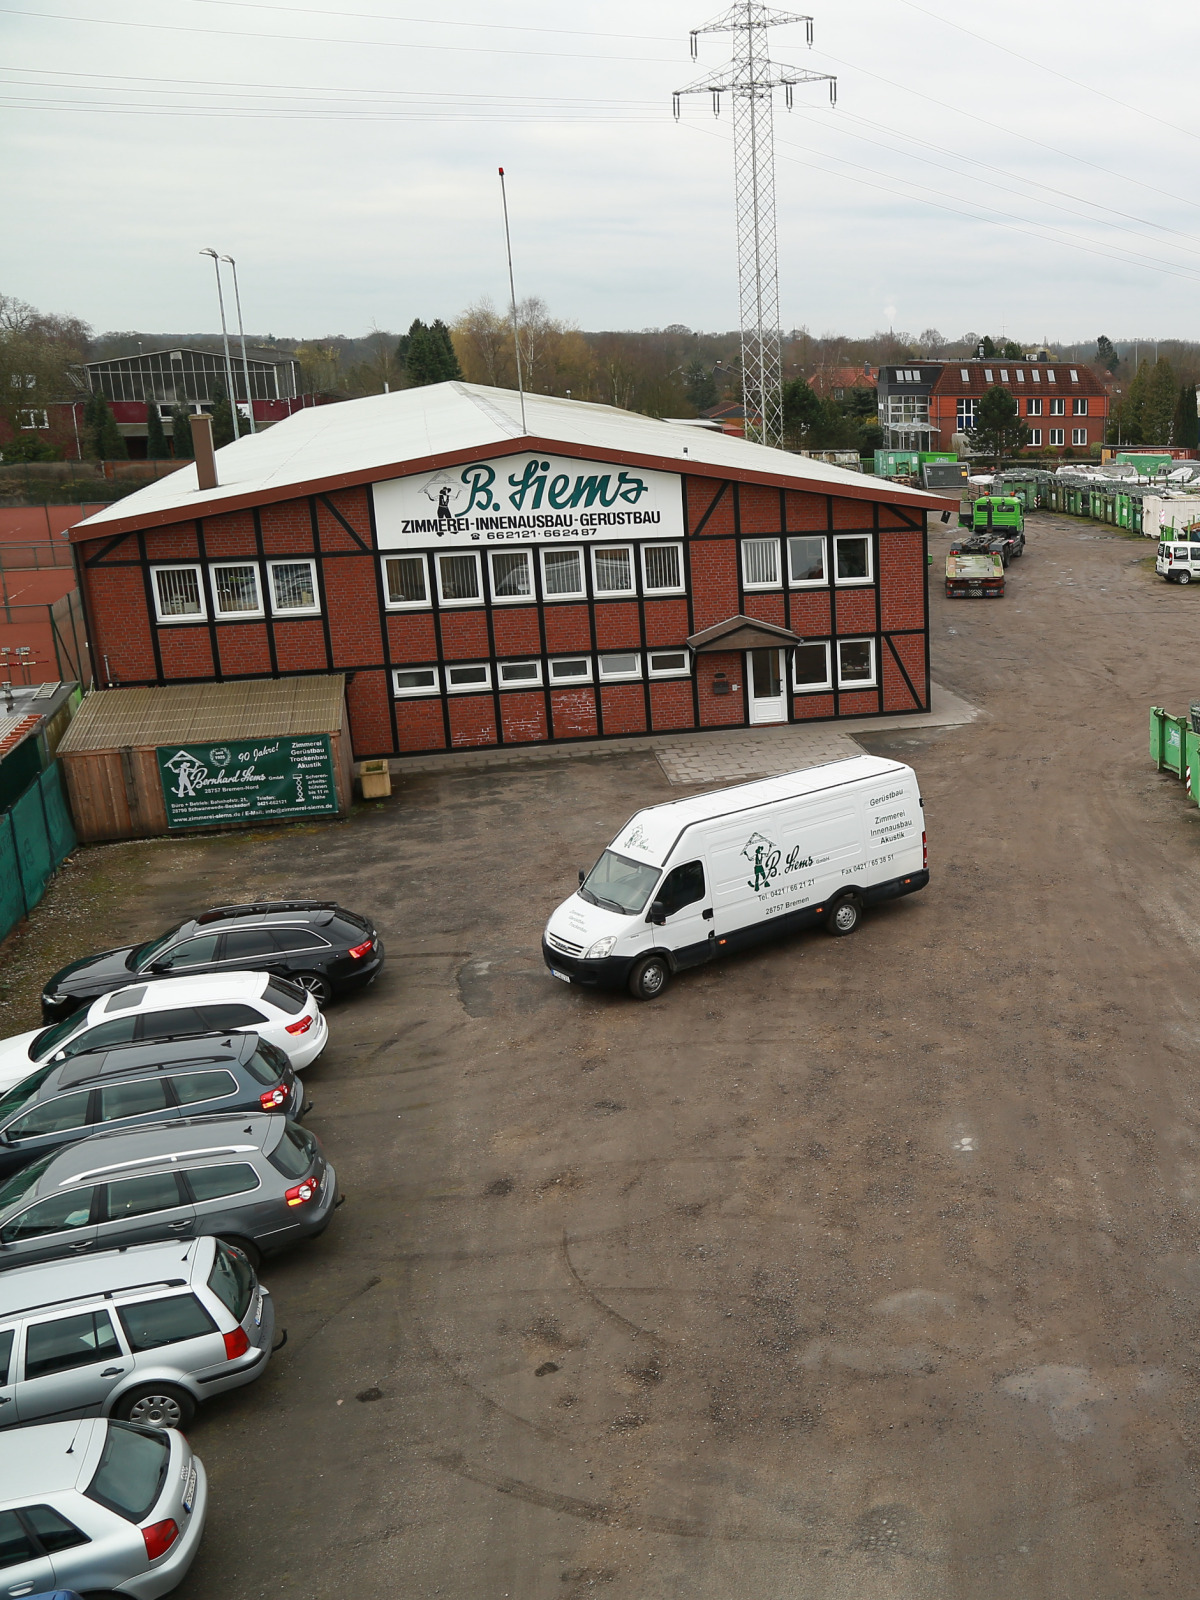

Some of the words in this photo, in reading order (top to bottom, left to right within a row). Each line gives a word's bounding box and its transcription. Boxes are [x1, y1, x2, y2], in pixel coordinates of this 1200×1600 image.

[455, 464, 500, 517] B.
[508, 460, 648, 511] Siems
[238, 752, 250, 762] 90
[253, 742, 279, 761] Jahre!
[291, 748, 325, 756] Gerüstbau
[292, 740, 322, 749] Zimmerei
[190, 767, 240, 788] Bernhard
[870, 789, 903, 806] Gerüstbau
[875, 810, 906, 824] Zimmerei
[870, 820, 912, 836] Innenausbau
[880, 832, 905, 844] Akustik
[765, 850, 781, 878] B.
[784, 845, 813, 874] Siems
[841, 867, 852, 876] Fax
[853, 862, 867, 872] 0421
[871, 858, 878, 866] 65
[758, 893, 769, 901] Tel.
[770, 888, 785, 898] 0421
[790, 884, 798, 892] 66
[800, 881, 806, 889] 21
[808, 878, 815, 886] 21
[765, 903, 784, 915] 28757
[785, 896, 809, 908] Bremen
